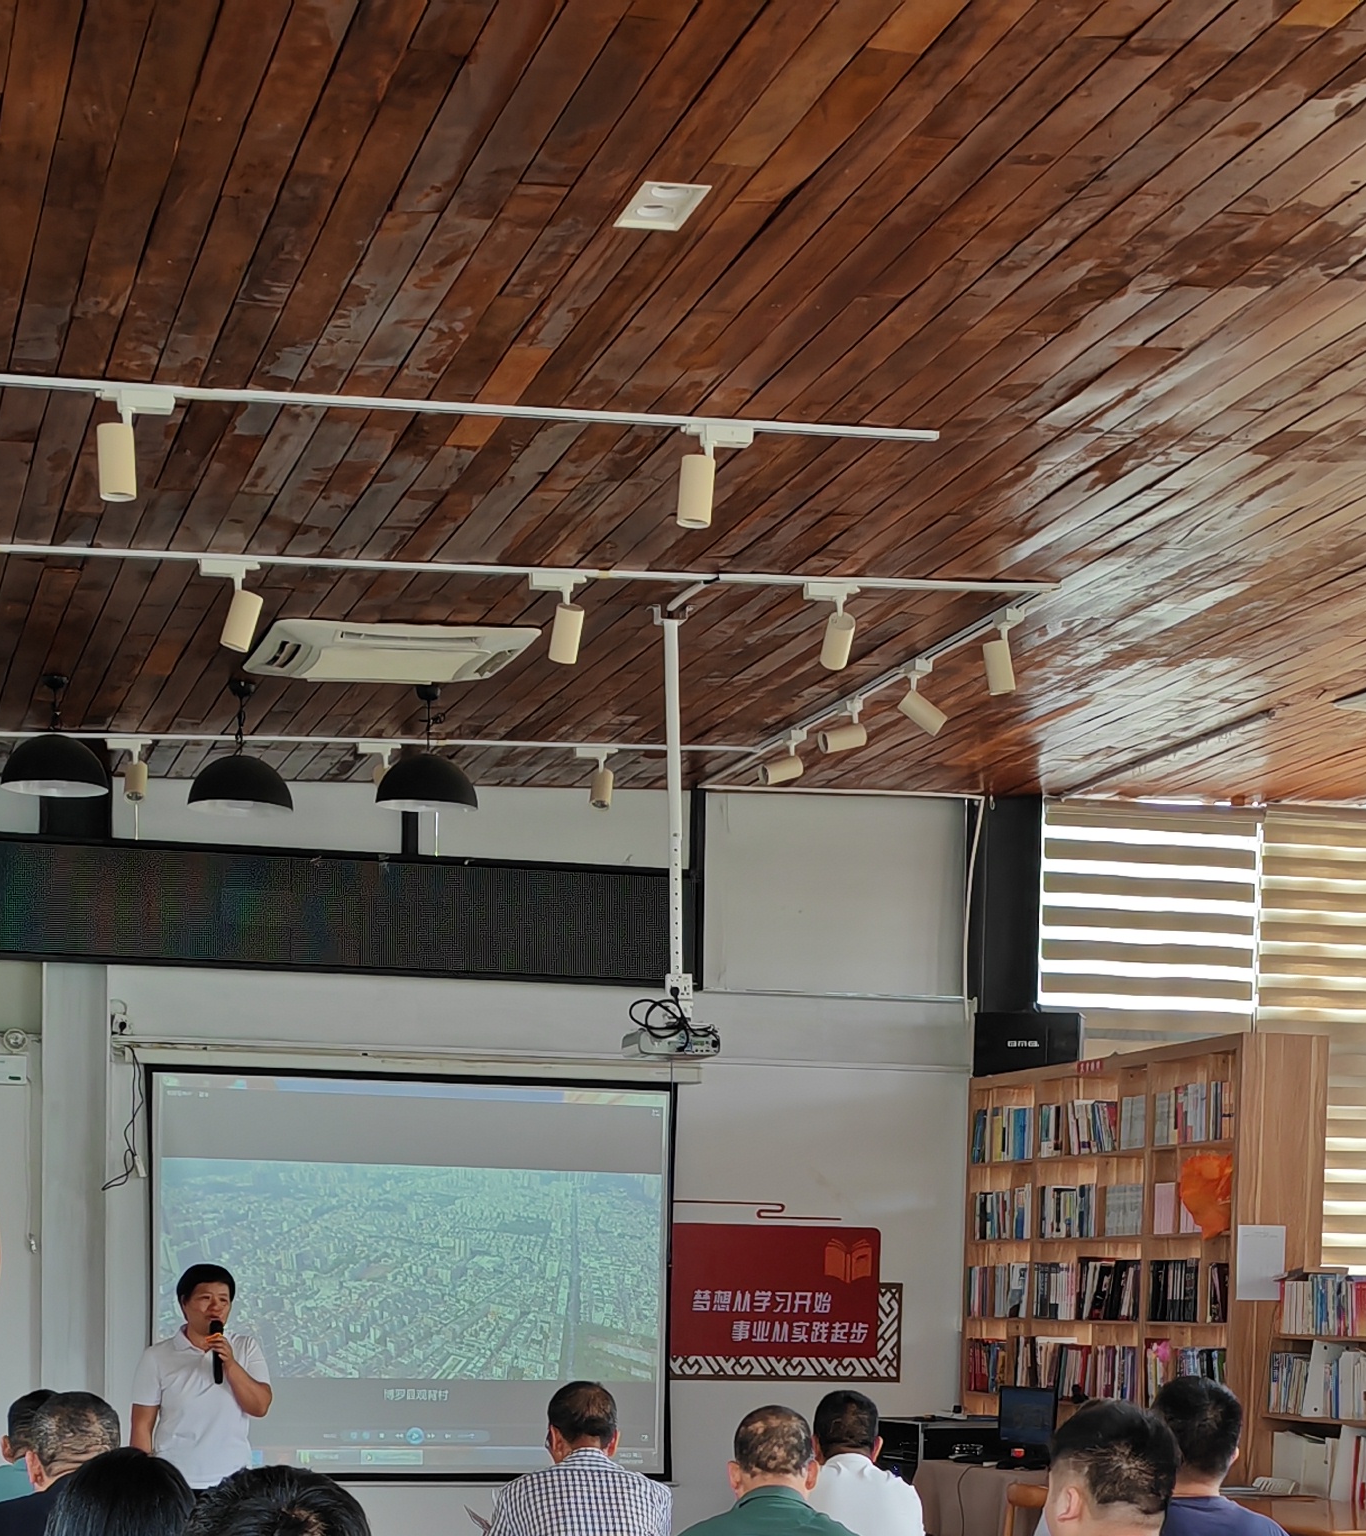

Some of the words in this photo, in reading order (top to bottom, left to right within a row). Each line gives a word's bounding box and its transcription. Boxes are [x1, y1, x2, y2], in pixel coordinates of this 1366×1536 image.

[691, 1288, 833, 1314] 梦想从学习开始
[731, 1319, 870, 1344] 事业从实践起步
